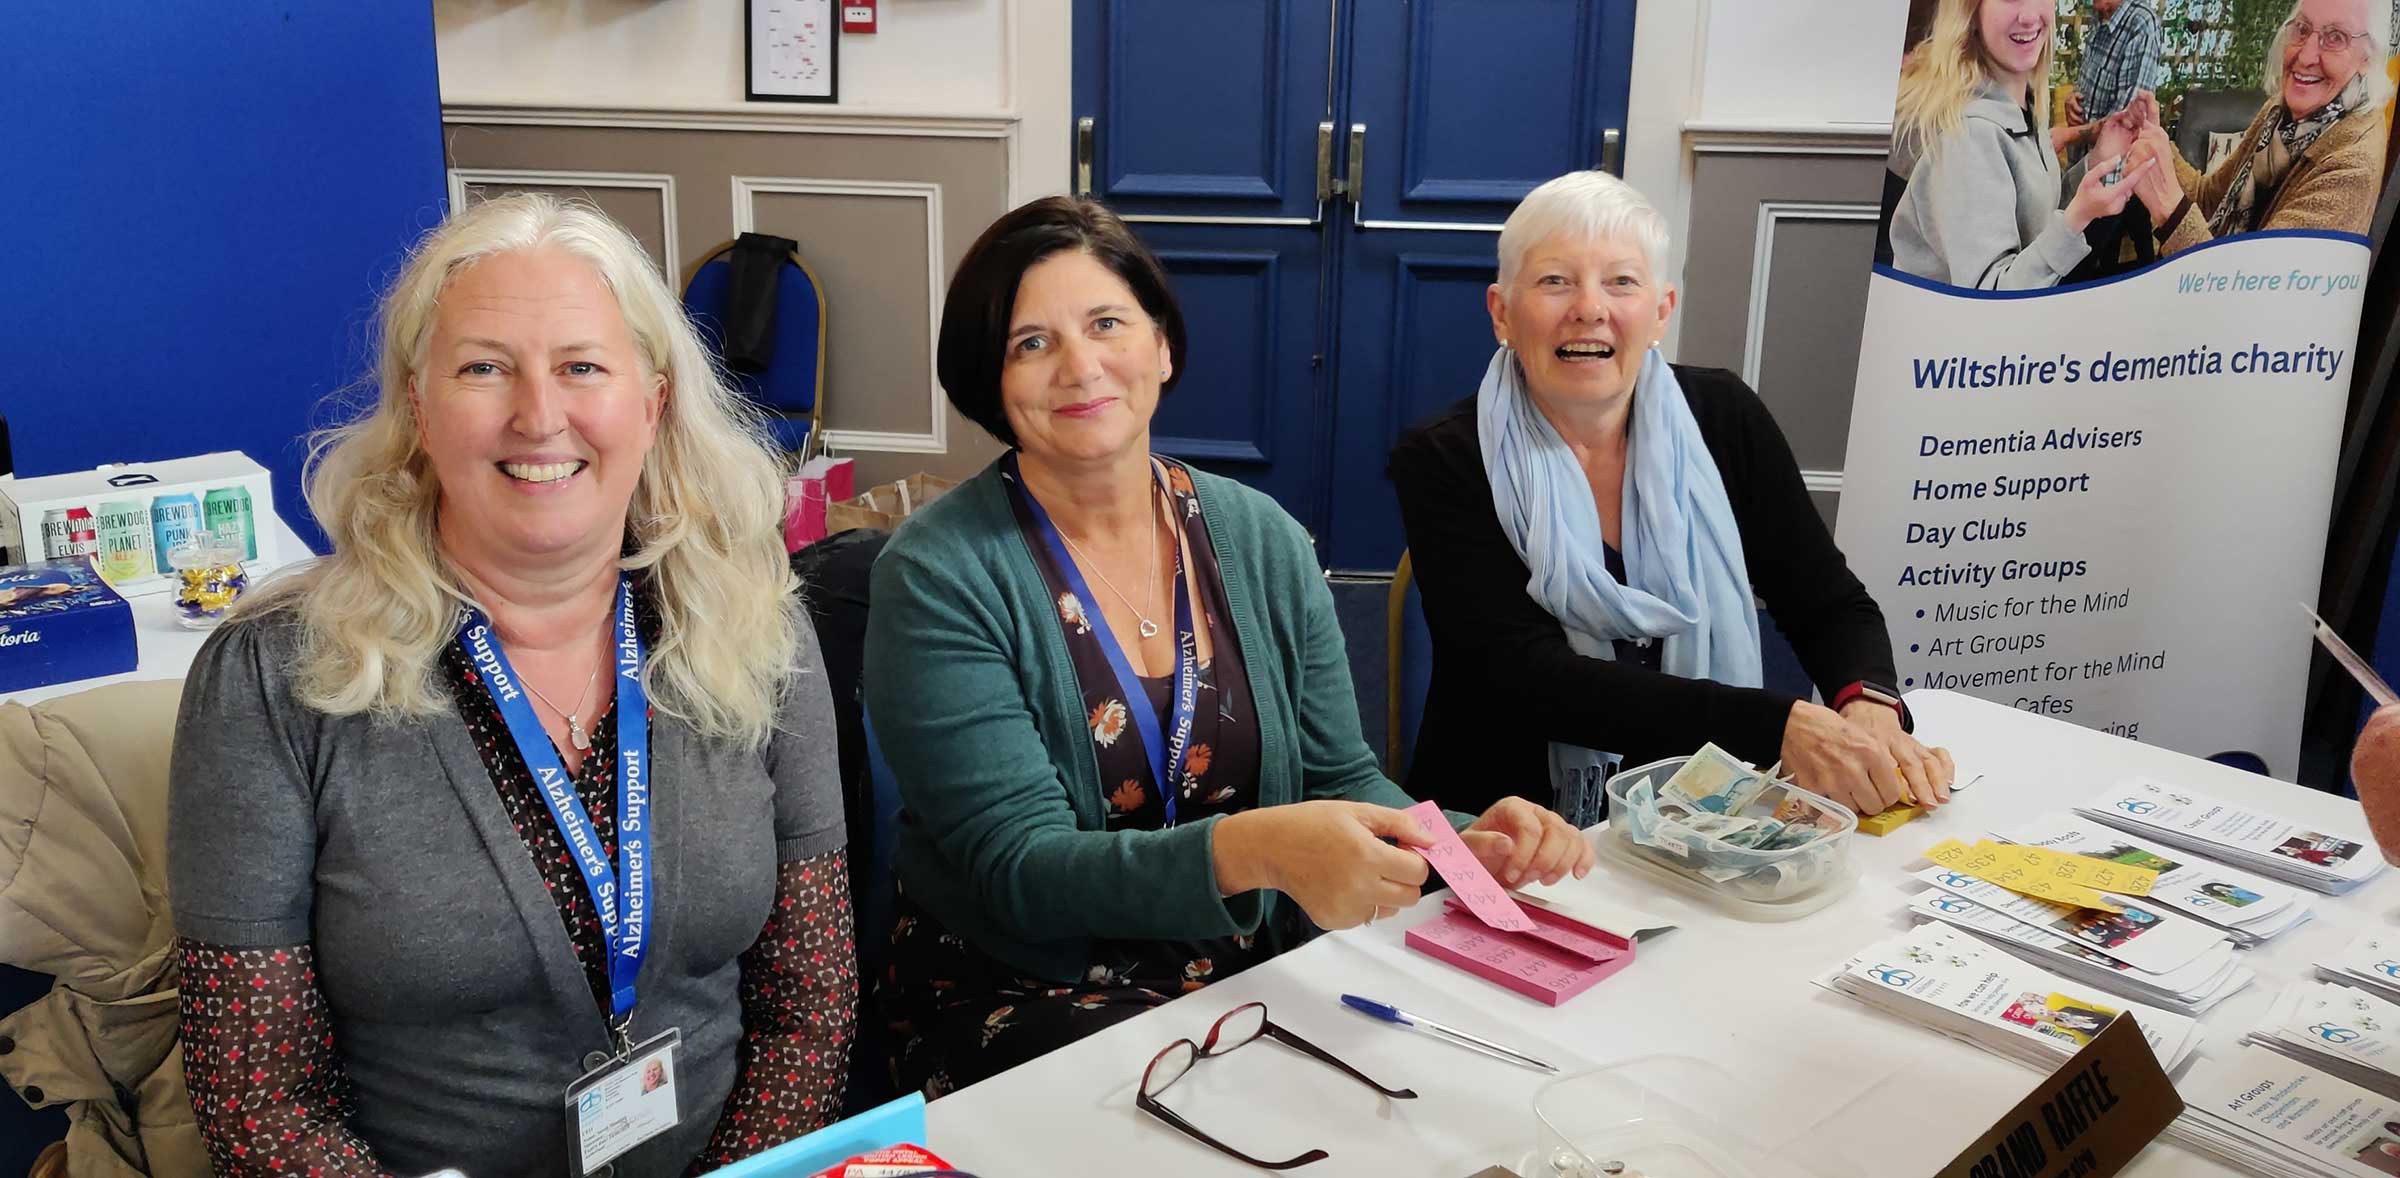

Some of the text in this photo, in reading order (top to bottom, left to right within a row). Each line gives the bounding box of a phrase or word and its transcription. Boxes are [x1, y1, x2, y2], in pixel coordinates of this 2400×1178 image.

[2178, 270, 2360, 297] We're here for you
[1913, 343, 2344, 389] Wiltshire's dementia charity
[1919, 426, 2143, 457] Dementia Advisers
[1912, 473, 2090, 501] Home Support
[108, 534, 142, 554] PLANET
[1906, 517, 2027, 549] Day Clubs
[58, 543, 85, 557] ELVIS
[1898, 559, 2087, 588] Activity Groups
[1934, 588, 2130, 623] Music for the Mind
[1927, 633, 2046, 657] Art Groups
[467, 624, 521, 702] Support
[1180, 631, 1198, 713] Alzheimer's
[1924, 651, 2165, 689] Movement for the Mind
[537, 766, 604, 877] Alzheimer's
[622, 749, 646, 958] Alzheimer's Support
[1935, 847, 1964, 862] 425
[1965, 853, 1997, 871] 435
[2095, 868, 2115, 887] 427
[2128, 875, 2151, 892] 426
[1519, 958, 1548, 977] 447
[1548, 972, 1579, 990] 446
[2040, 1058, 2120, 1152] RAFFLE
[2228, 1098, 2246, 1112] Art
[2239, 1079, 2275, 1102] Groups
